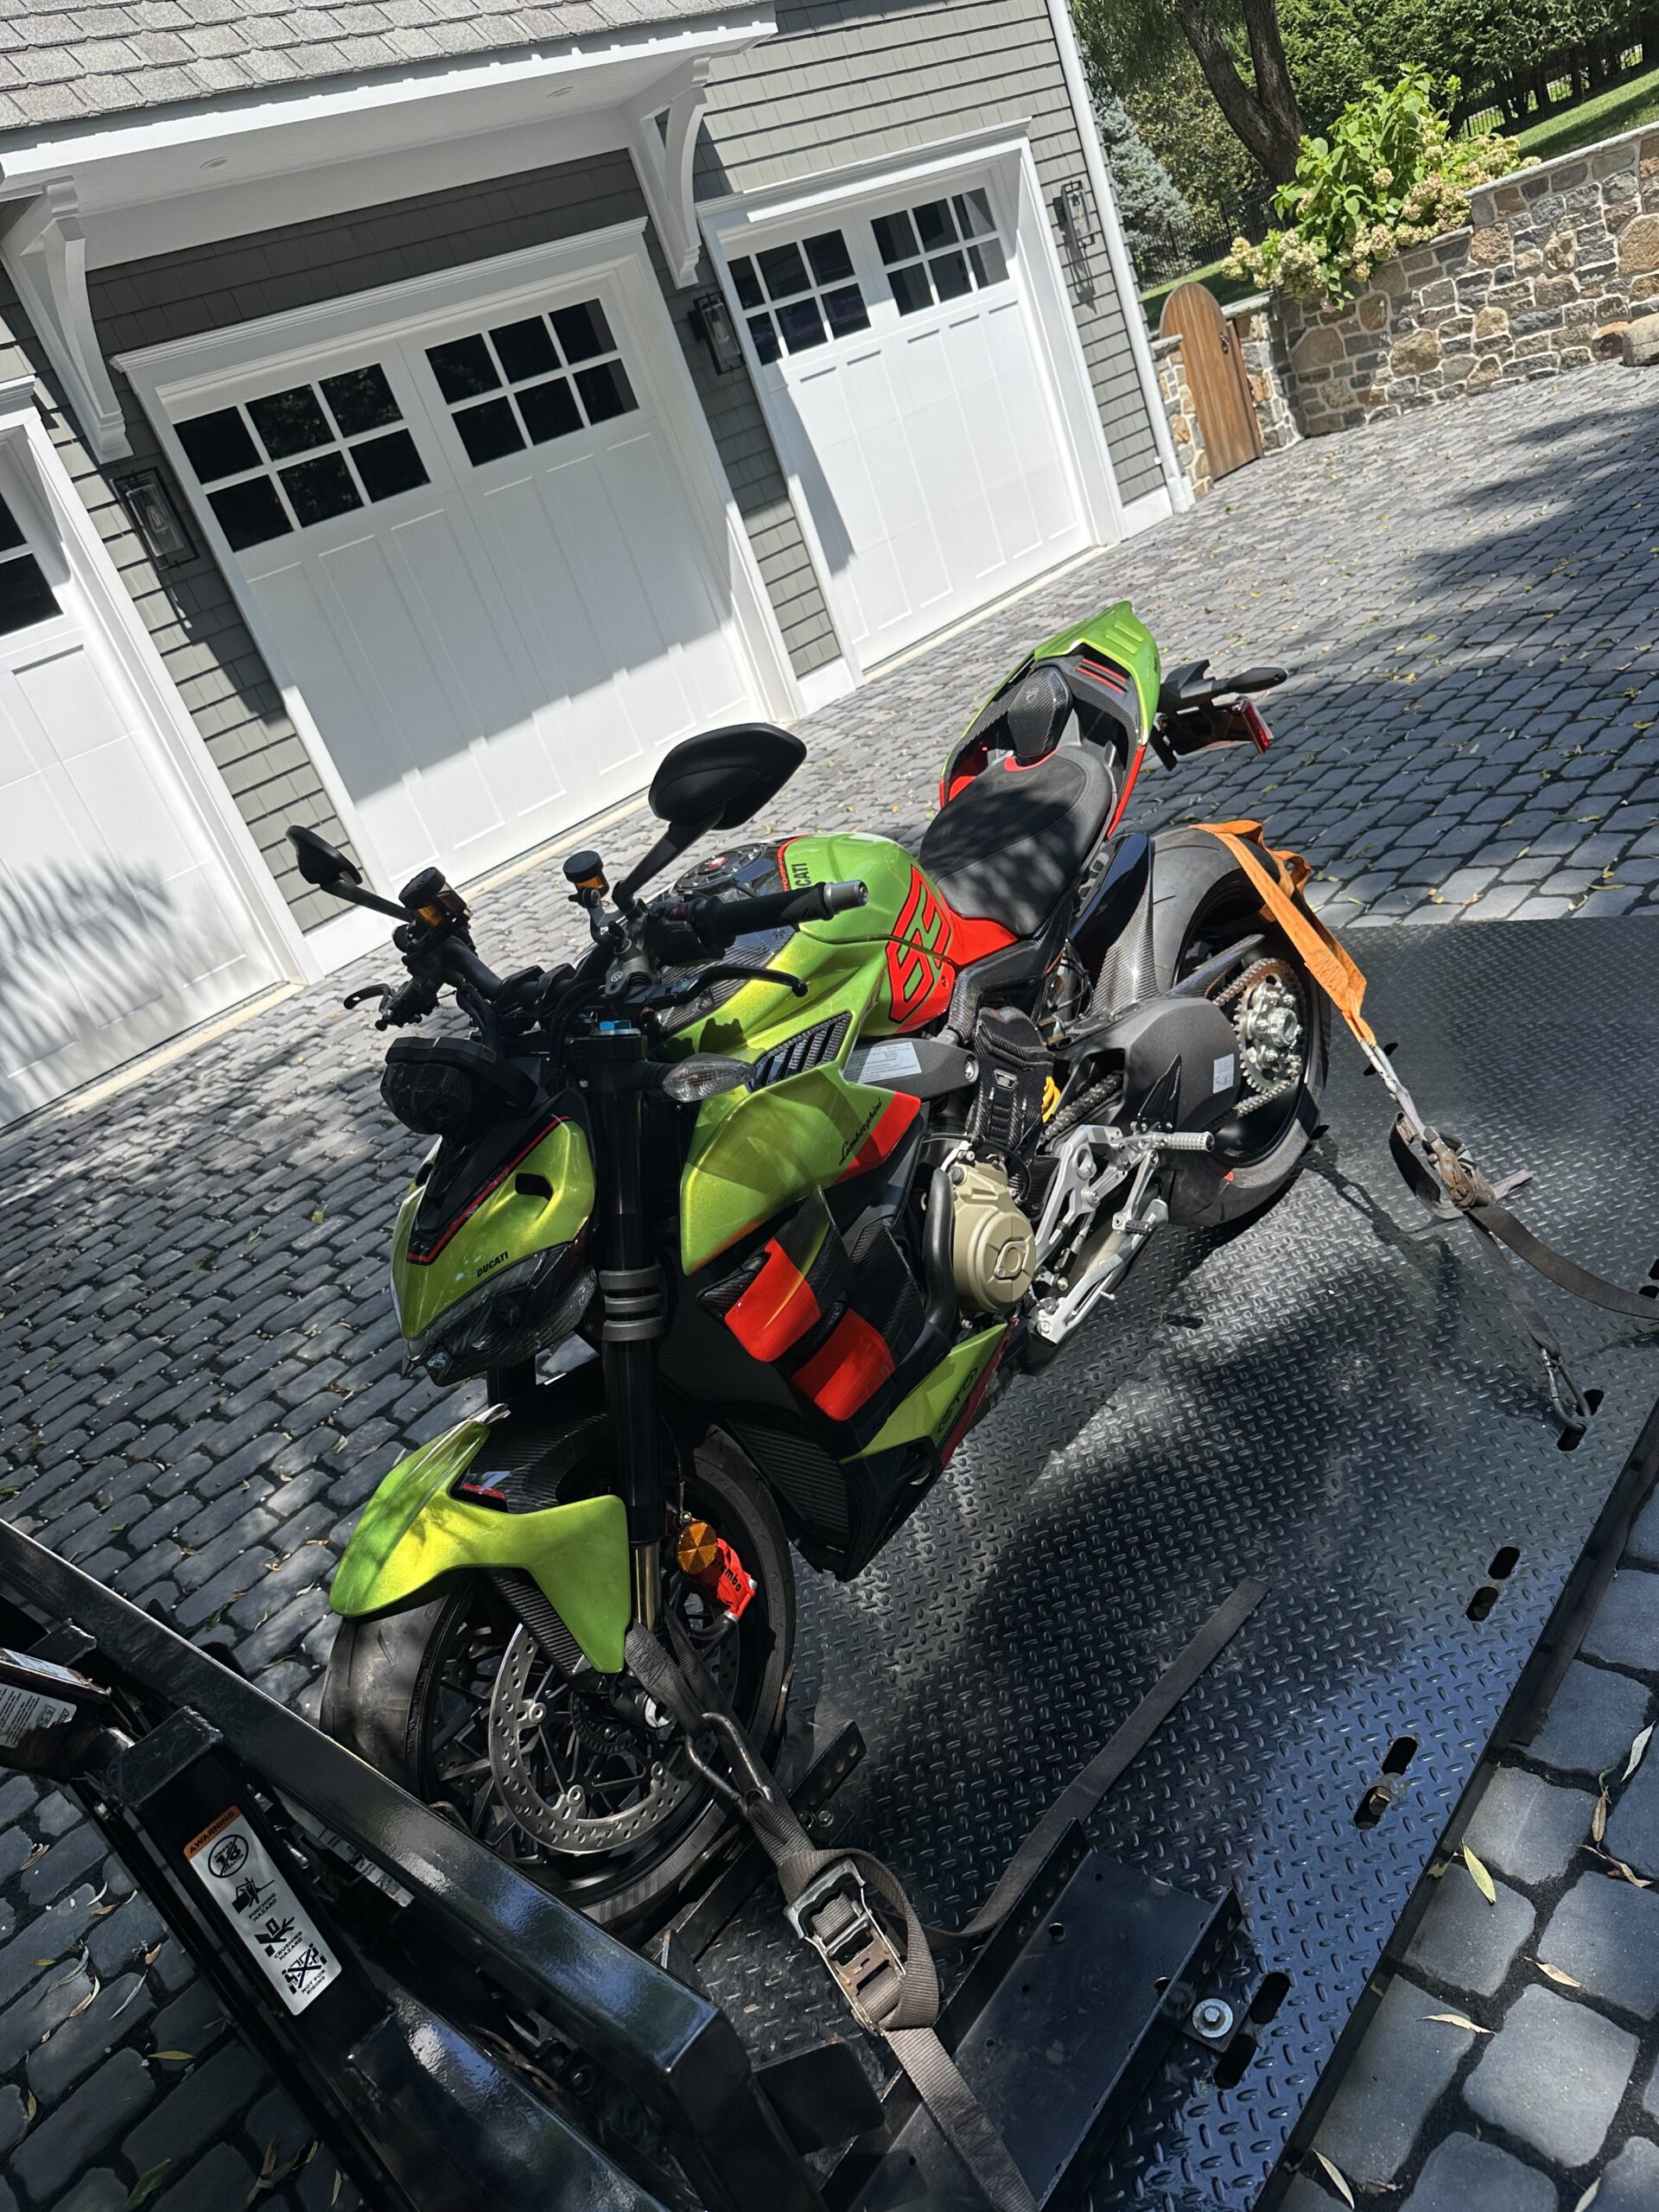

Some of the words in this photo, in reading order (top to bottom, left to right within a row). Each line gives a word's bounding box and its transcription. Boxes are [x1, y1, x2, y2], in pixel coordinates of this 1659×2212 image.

[791, 862, 811, 887] CATI
[839, 1097, 882, 1166] Lamborghini
[477, 1250, 508, 1278] DUCATI
[248, 1892, 276, 1919] PINCHING
[253, 1897, 277, 1922] HAZARD
[274, 1931, 302, 1959] CRUSHING
[279, 1937, 302, 1961] HAZARD
[302, 1980, 314, 1993] NOT
[314, 1969, 326, 1981] FOR
[307, 1976, 326, 1995] RIDING
